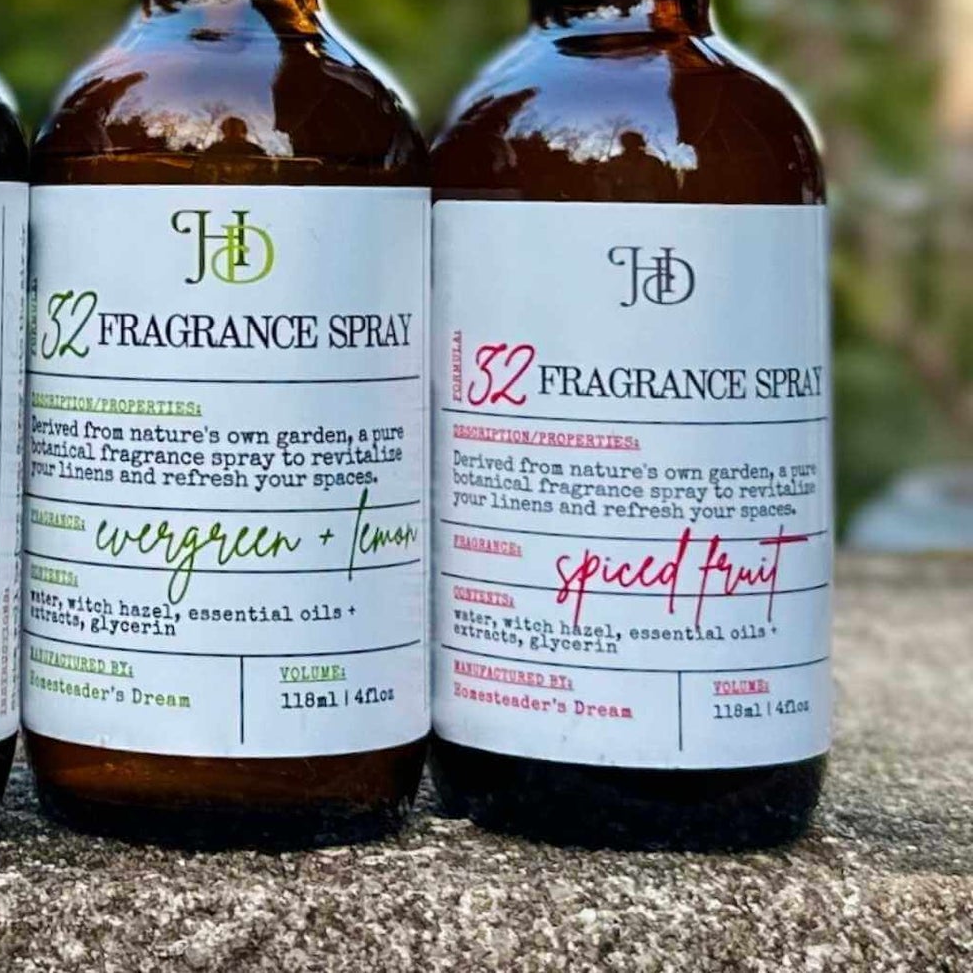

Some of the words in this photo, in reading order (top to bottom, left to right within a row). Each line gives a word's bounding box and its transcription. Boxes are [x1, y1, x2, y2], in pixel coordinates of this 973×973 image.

[41, 289, 98, 360] 32
[97, 311, 318, 349] FRAGRANCE
[328, 313, 412, 349] SPRAY
[467, 342, 535, 406] 32
[537, 363, 747, 400] FRAGRANCE
[754, 364, 825, 400] SPRAY
[31, 414, 79, 438] Derived
[83, 421, 124, 440] from
[129, 424, 221, 444] nature's
[227, 429, 270, 445] own
[276, 425, 354, 449] garden,
[358, 428, 369, 442] a
[371, 426, 405, 447] pure
[30, 436, 95, 461] botanical
[100, 443, 205, 467] fragrance
[211, 450, 276, 471] spray
[282, 449, 306, 467] to
[311, 445, 403, 467] revitalize
[452, 448, 514, 473] Derived
[519, 457, 564, 476] from
[569, 461, 659, 480] nature's
[664, 466, 702, 480] own
[709, 463, 774, 485] garden,
[778, 466, 787, 478] a
[790, 463, 818, 482] pure
[30, 460, 56, 478] your
[59, 460, 114, 482] linens
[120, 468, 156, 484] and
[162, 468, 249, 488] refresh
[254, 475, 308, 493] your
[312, 470, 379, 491] spaces.
[452, 468, 533, 493] botanical
[539, 477, 644, 500] fragrance
[650, 485, 708, 503] spray
[714, 483, 734, 499] to
[452, 490, 487, 508] your
[491, 492, 554, 513] linens
[559, 500, 597, 517] and
[603, 501, 685, 518] refresh
[690, 504, 736, 523] your
[740, 502, 797, 522] spaces.
[95, 518, 303, 605] evergreen
[318, 529, 335, 546] +
[347, 487, 418, 581] lemon
[555, 527, 691, 628] spiced
[694, 525, 809, 629] fruit
[67, 595, 113, 615] witch
[119, 599, 181, 622] hazel,
[188, 605, 293, 623] essential
[300, 604, 342, 622] oils
[347, 605, 357, 617] +
[90, 614, 177, 636] glycerin
[453, 607, 497, 628] water,
[503, 615, 555, 634] witch
[560, 620, 622, 641] hazel,
[628, 624, 726, 642] essential
[730, 625, 766, 640] oils
[453, 622, 524, 648] extracts,
[529, 633, 618, 654] glycerin
[279, 664, 347, 684] VOLUME:
[453, 658, 545, 687] MANUFACTURED
[712, 679, 771, 697] VOLUME:
[132, 687, 191, 708] Dream
[280, 692, 339, 710] 118ml
[354, 687, 395, 704] 4floz
[453, 681, 568, 714] Homesteader's
[573, 699, 634, 719] Dream
[713, 703, 763, 720] 118ml
